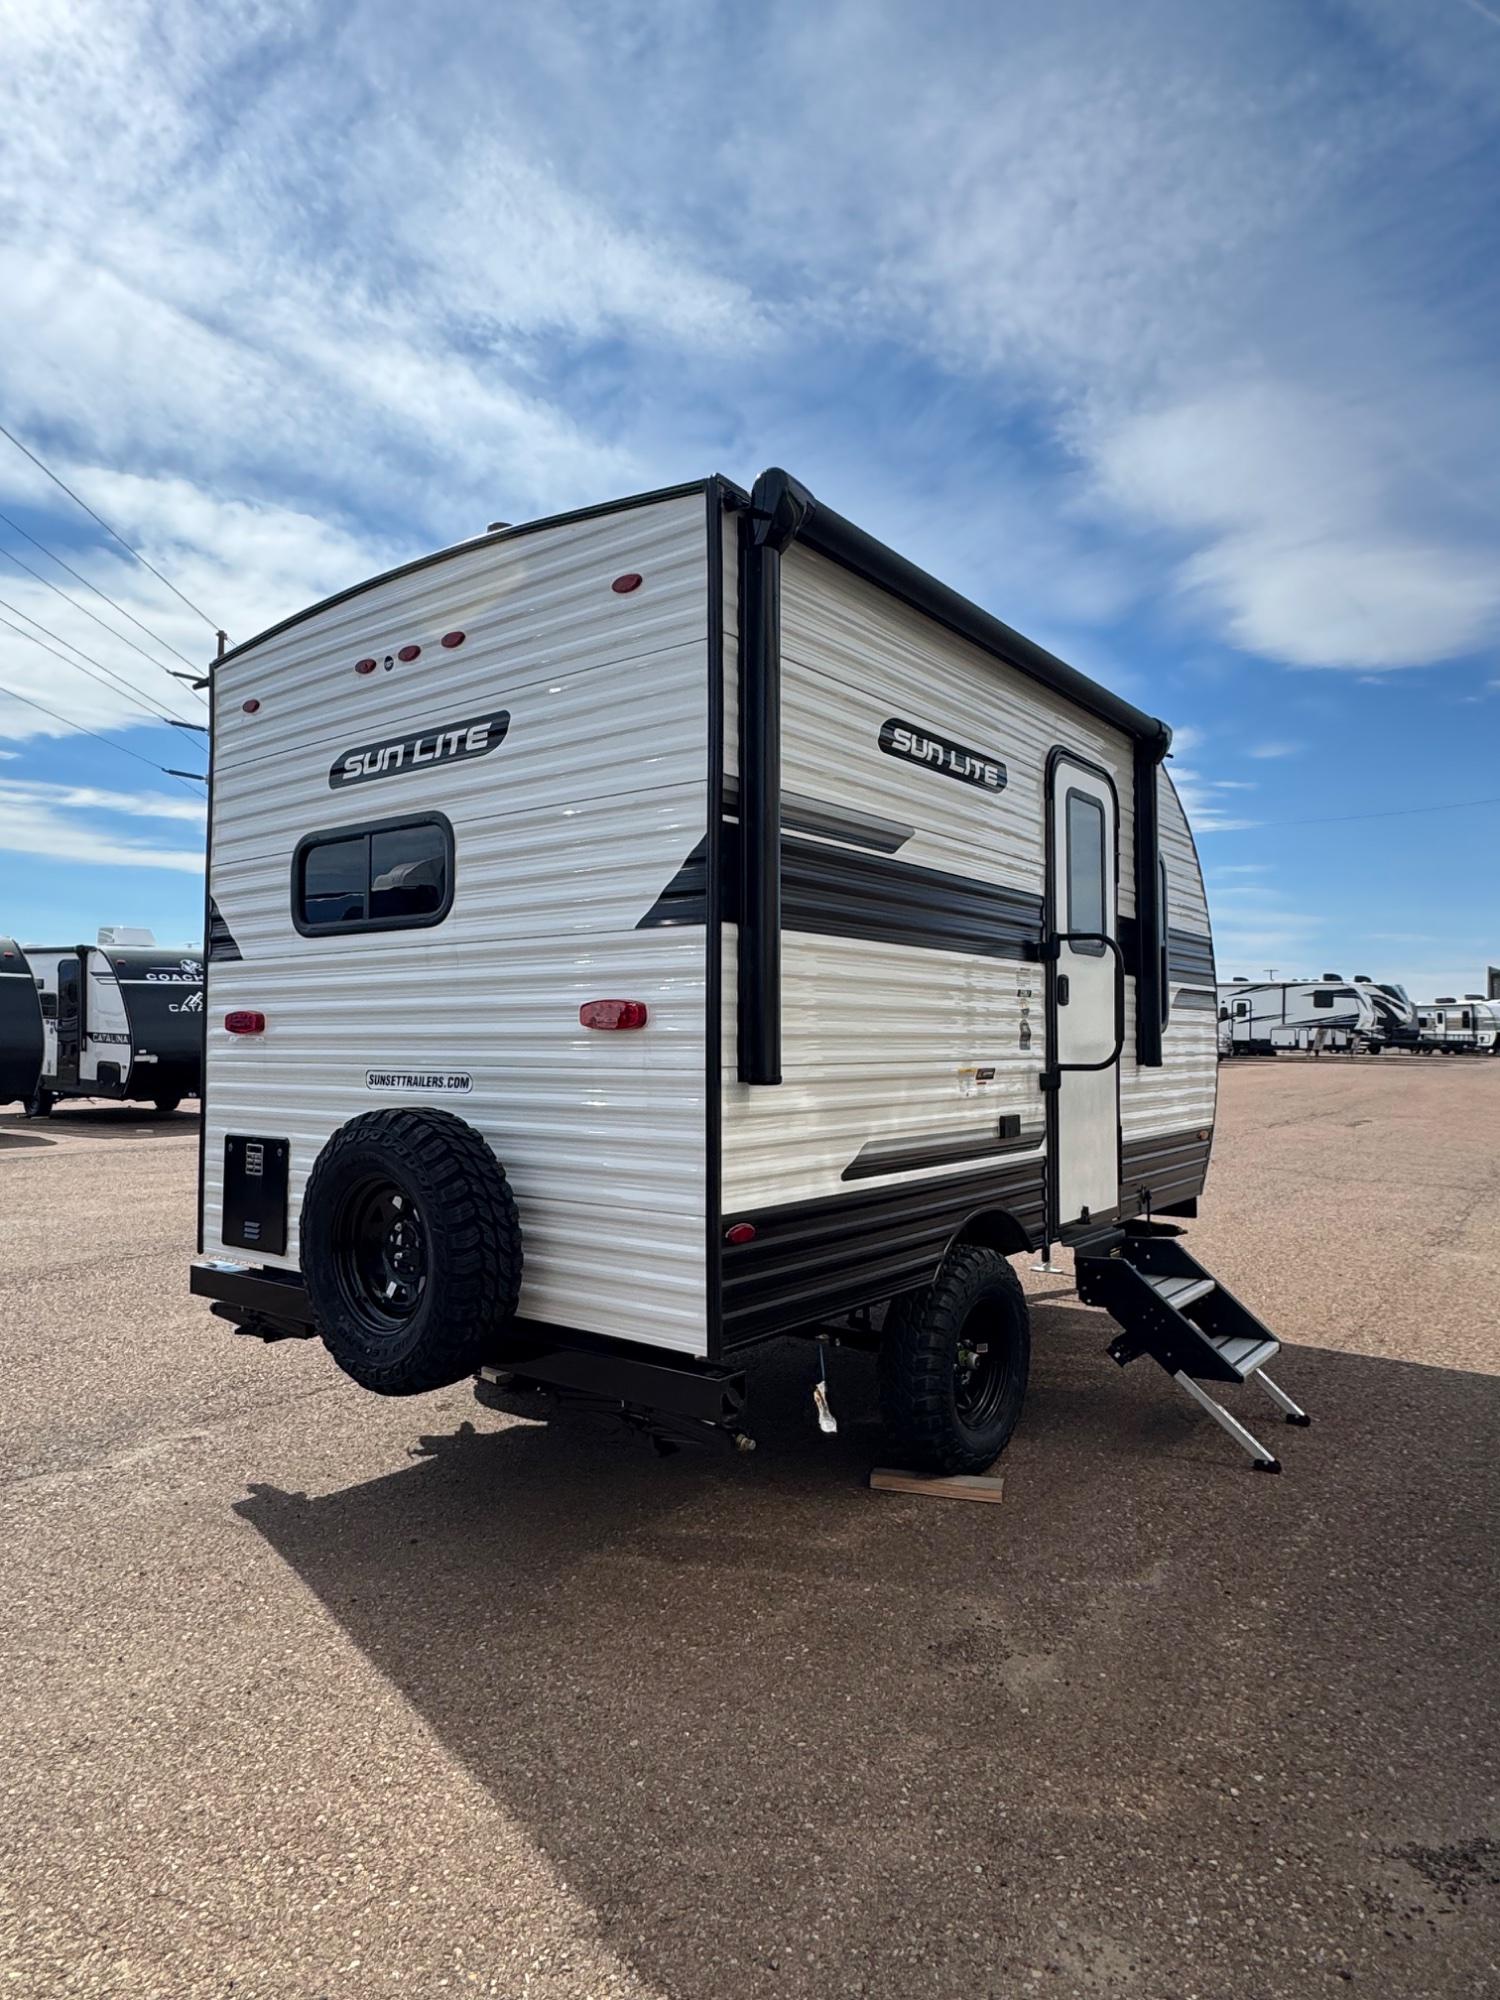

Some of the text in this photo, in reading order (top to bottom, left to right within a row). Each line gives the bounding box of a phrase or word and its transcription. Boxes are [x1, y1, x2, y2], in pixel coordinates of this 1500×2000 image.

[342, 722, 492, 780] SUN LITE
[891, 728, 998, 786] SUN LITE
[92, 1033, 129, 1043] CATALINA
[368, 1074, 470, 1089] SUNSETTRAILERS.COM
